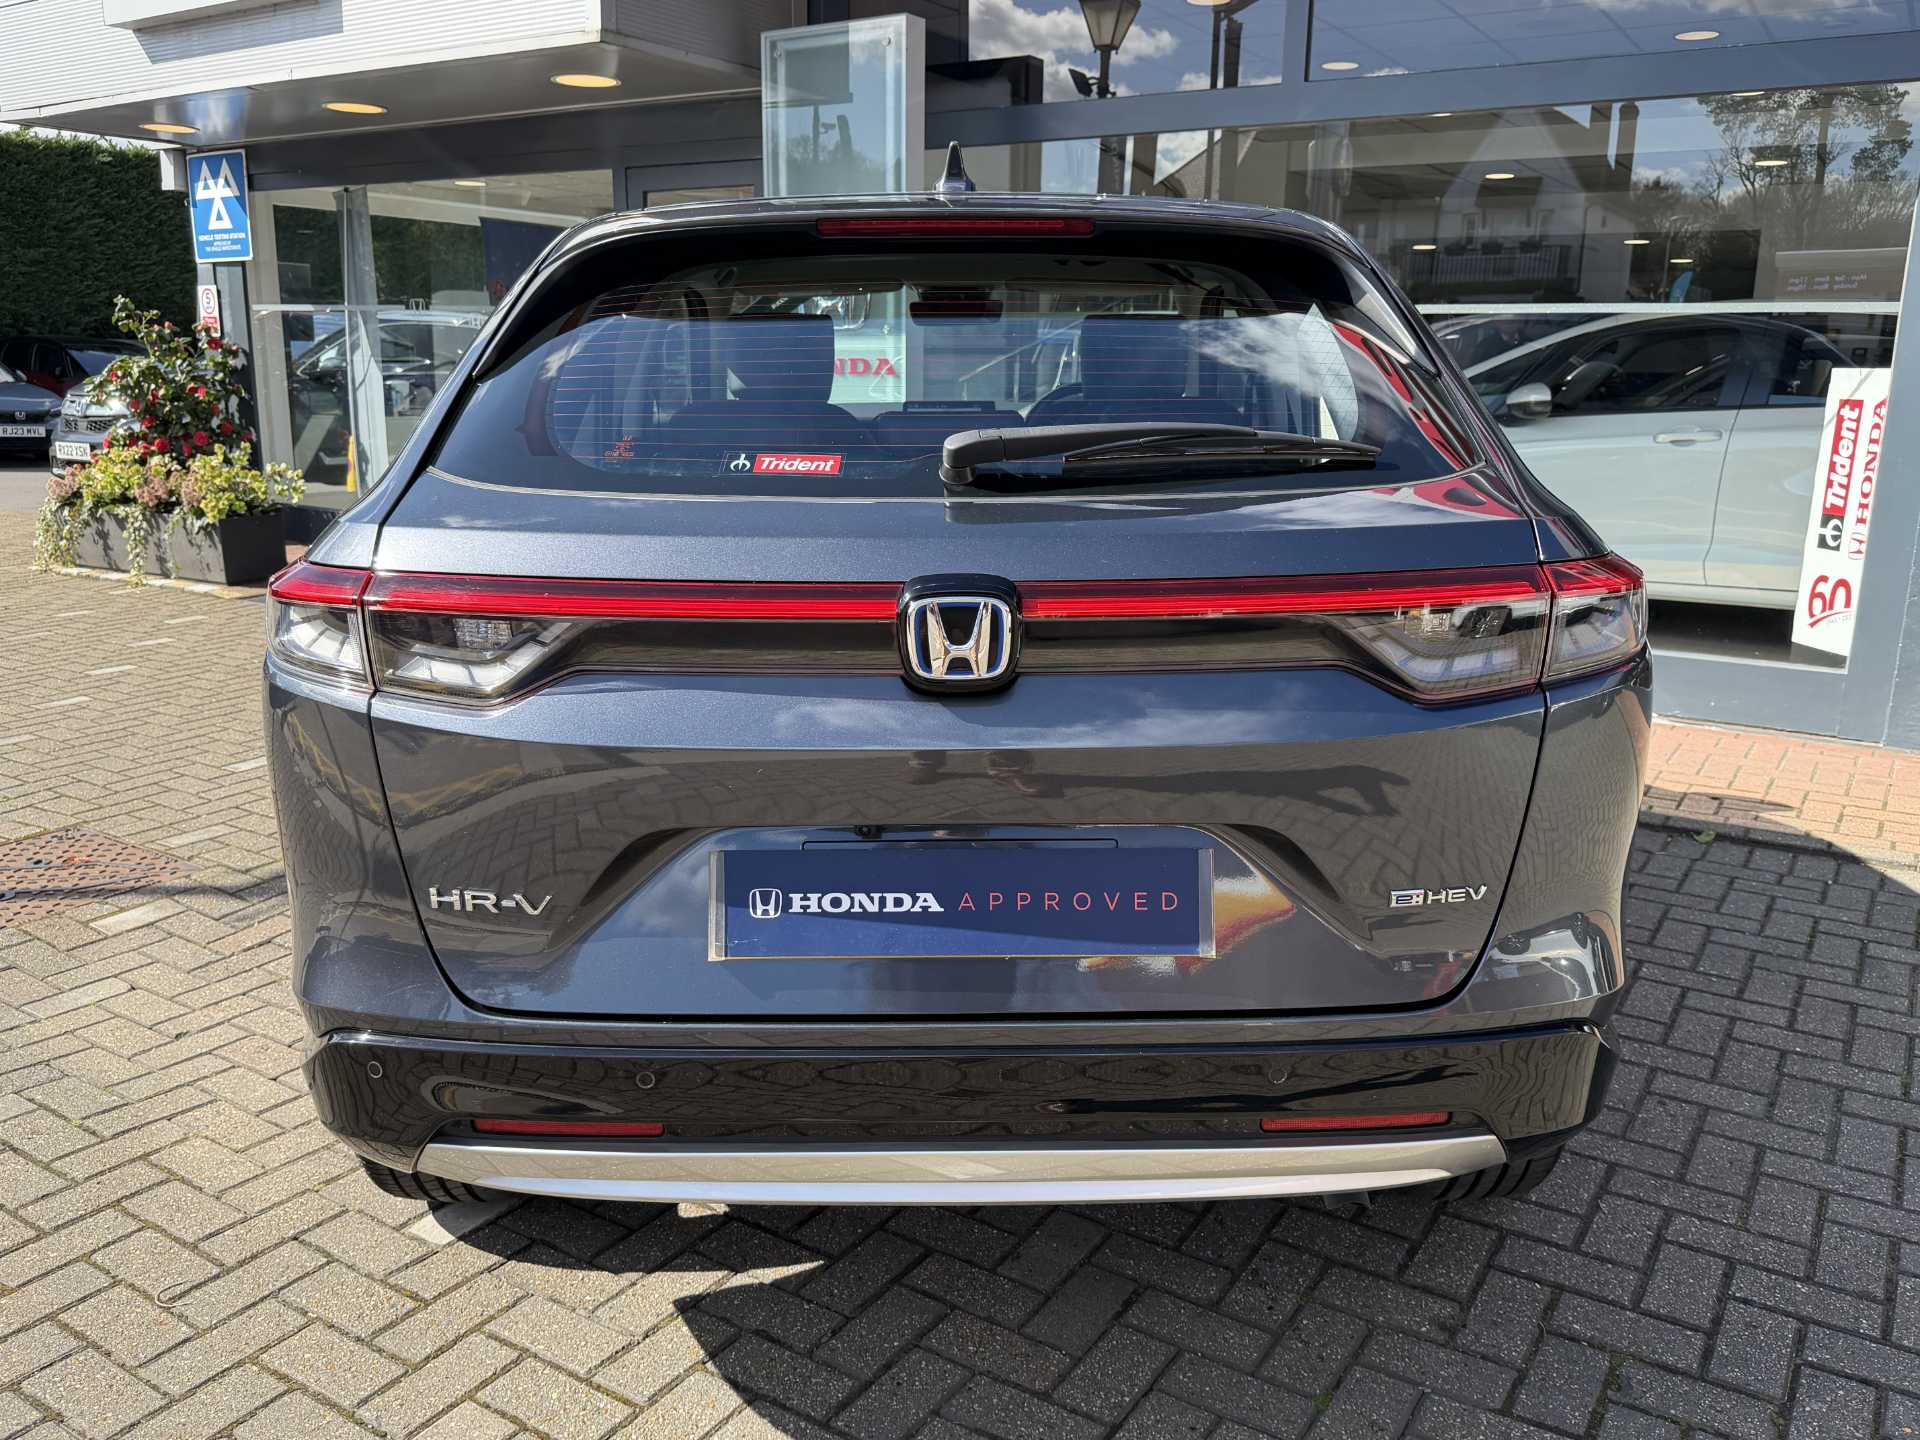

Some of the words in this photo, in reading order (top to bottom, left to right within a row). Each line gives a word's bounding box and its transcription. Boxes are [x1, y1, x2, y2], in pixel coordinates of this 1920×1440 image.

[761, 457, 835, 472] Trident
[1825, 405, 1860, 509] Trident
[1855, 396, 1889, 526] HONDA
[429, 887, 552, 915] HR-V
[788, 892, 945, 913] HONDA
[958, 892, 1178, 912] APPROVED
